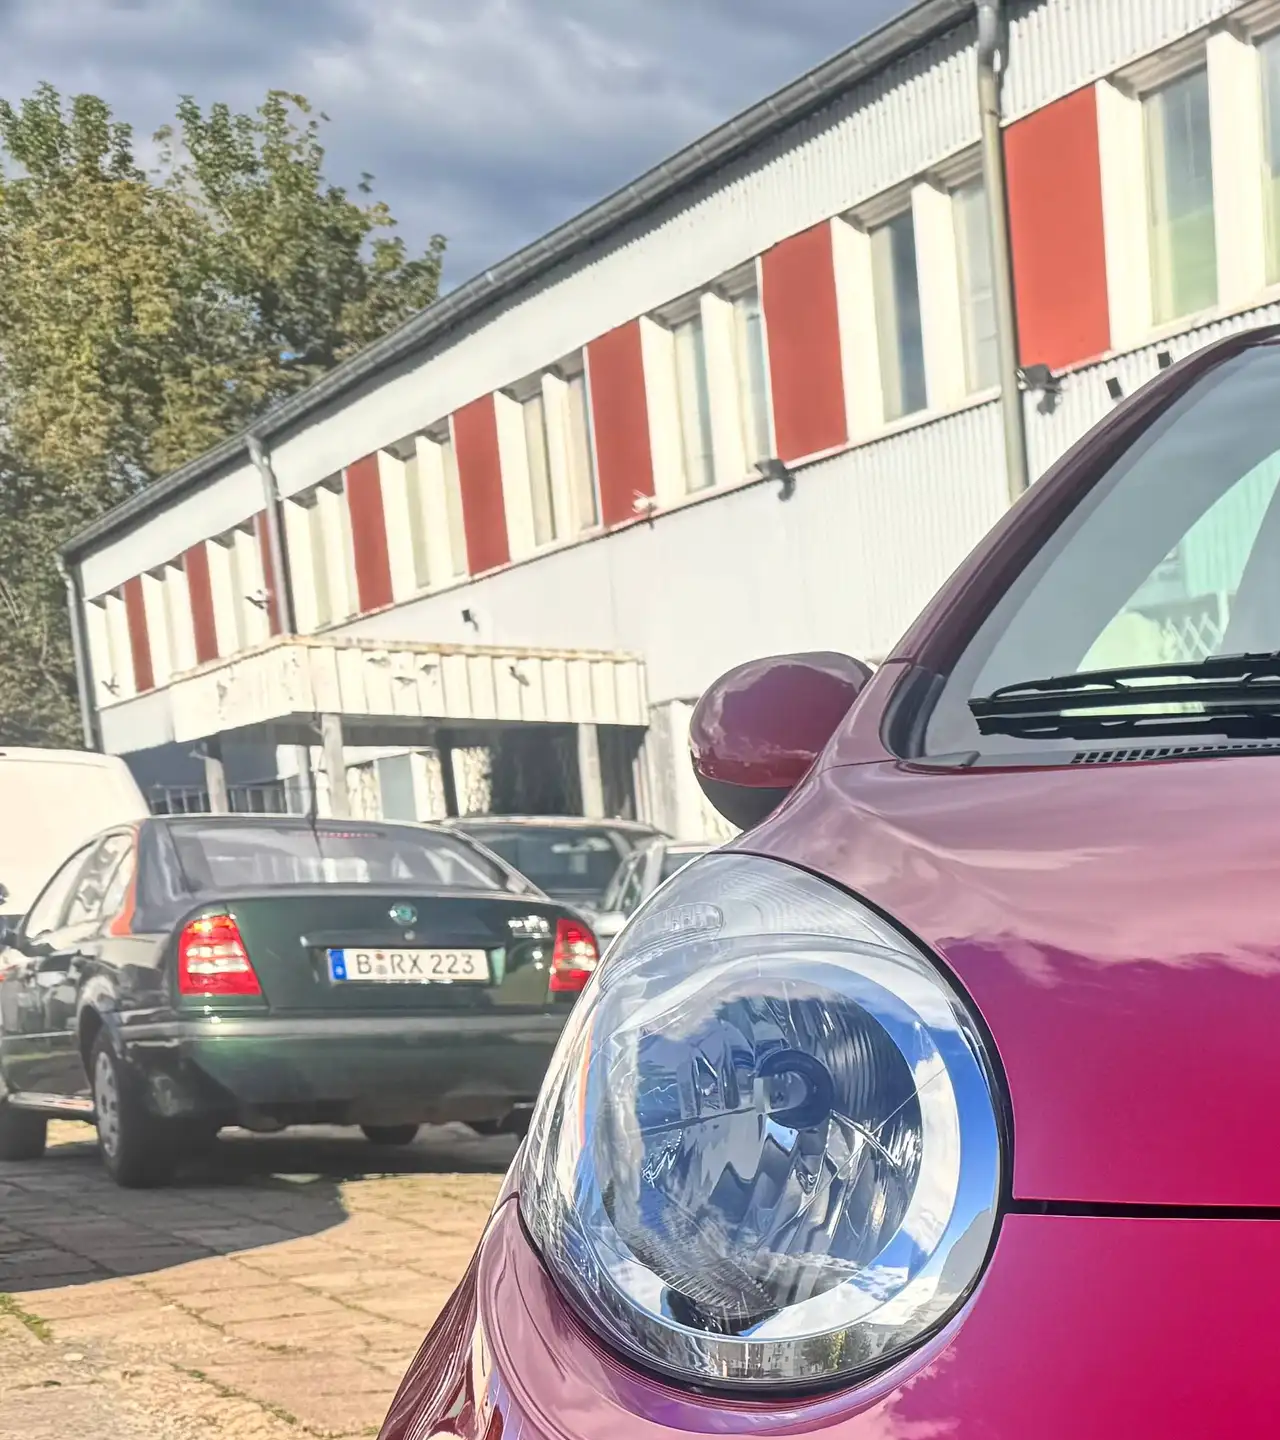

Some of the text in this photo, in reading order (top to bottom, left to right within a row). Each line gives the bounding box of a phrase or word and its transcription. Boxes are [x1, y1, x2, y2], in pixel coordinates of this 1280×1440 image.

[356, 953, 475, 975] B RX 223
